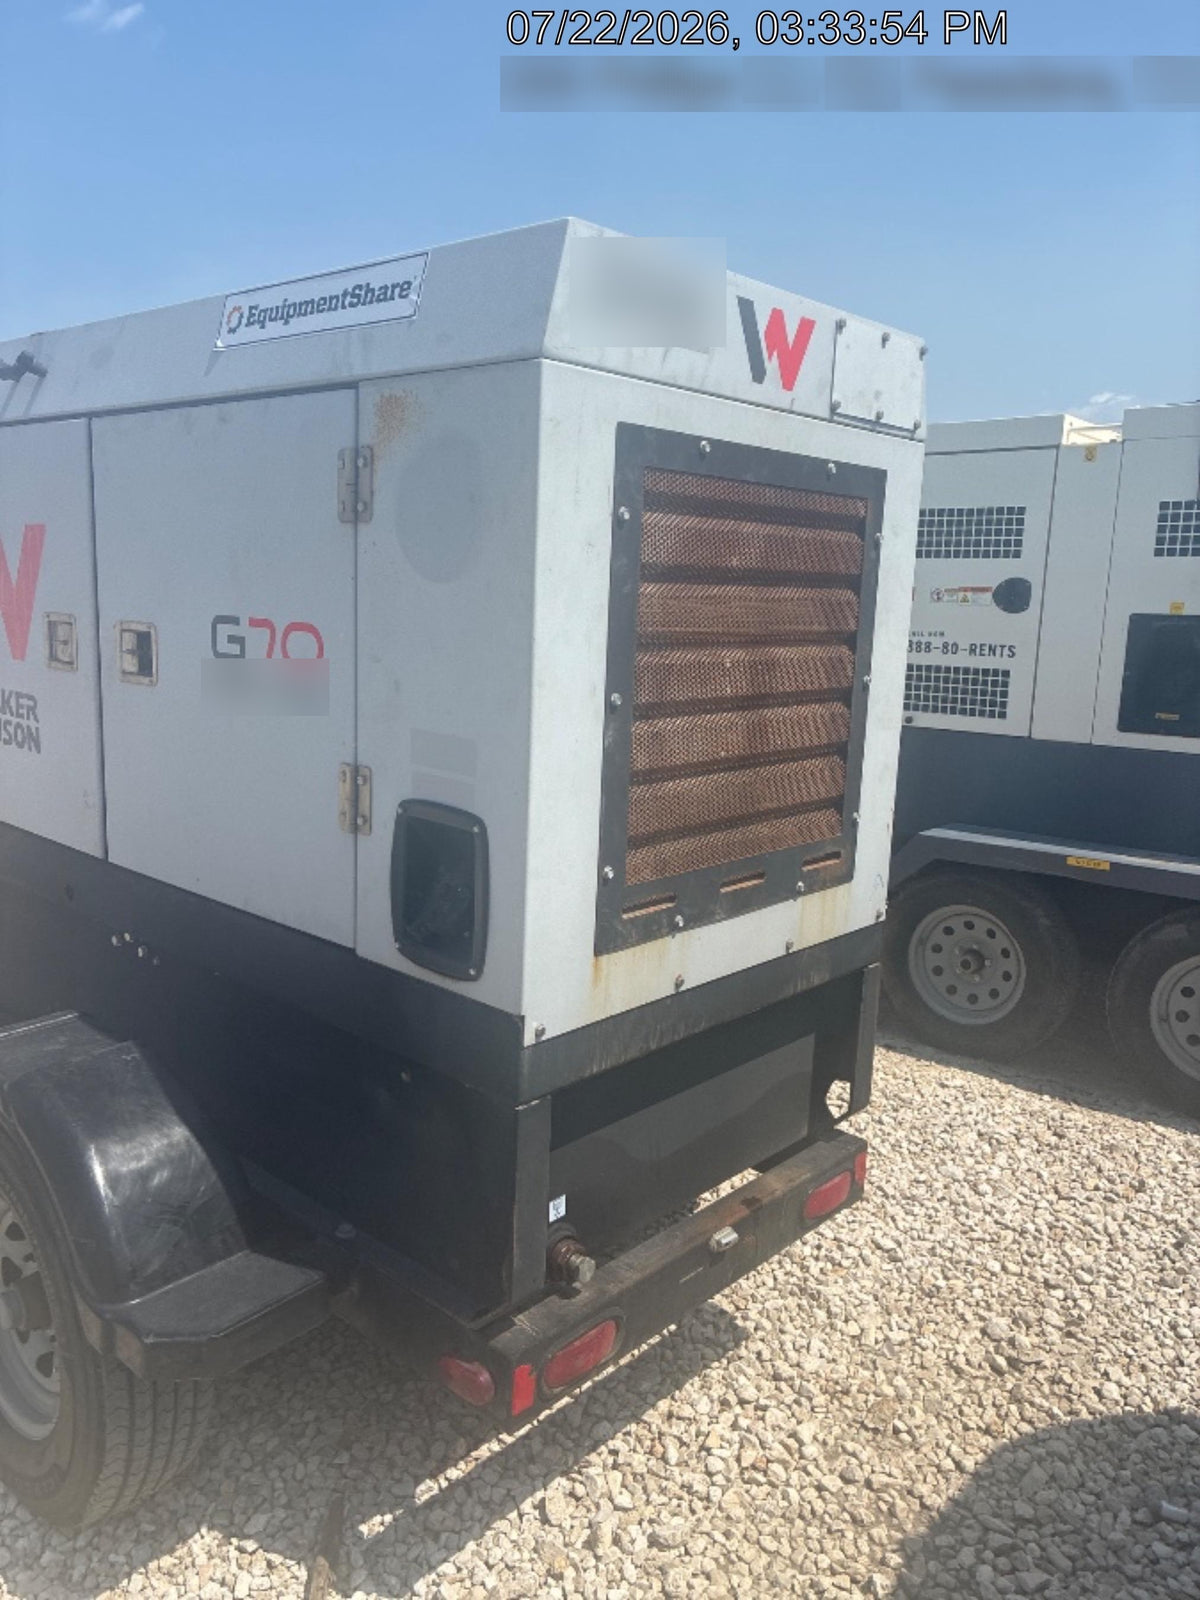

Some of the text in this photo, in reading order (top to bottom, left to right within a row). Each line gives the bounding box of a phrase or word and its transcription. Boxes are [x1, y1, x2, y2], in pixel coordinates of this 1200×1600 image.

[245, 280, 412, 329] EquipmentShare
[211, 615, 325, 659] G70
[0, 688, 39, 723] KER
[0, 718, 41, 754] SON
